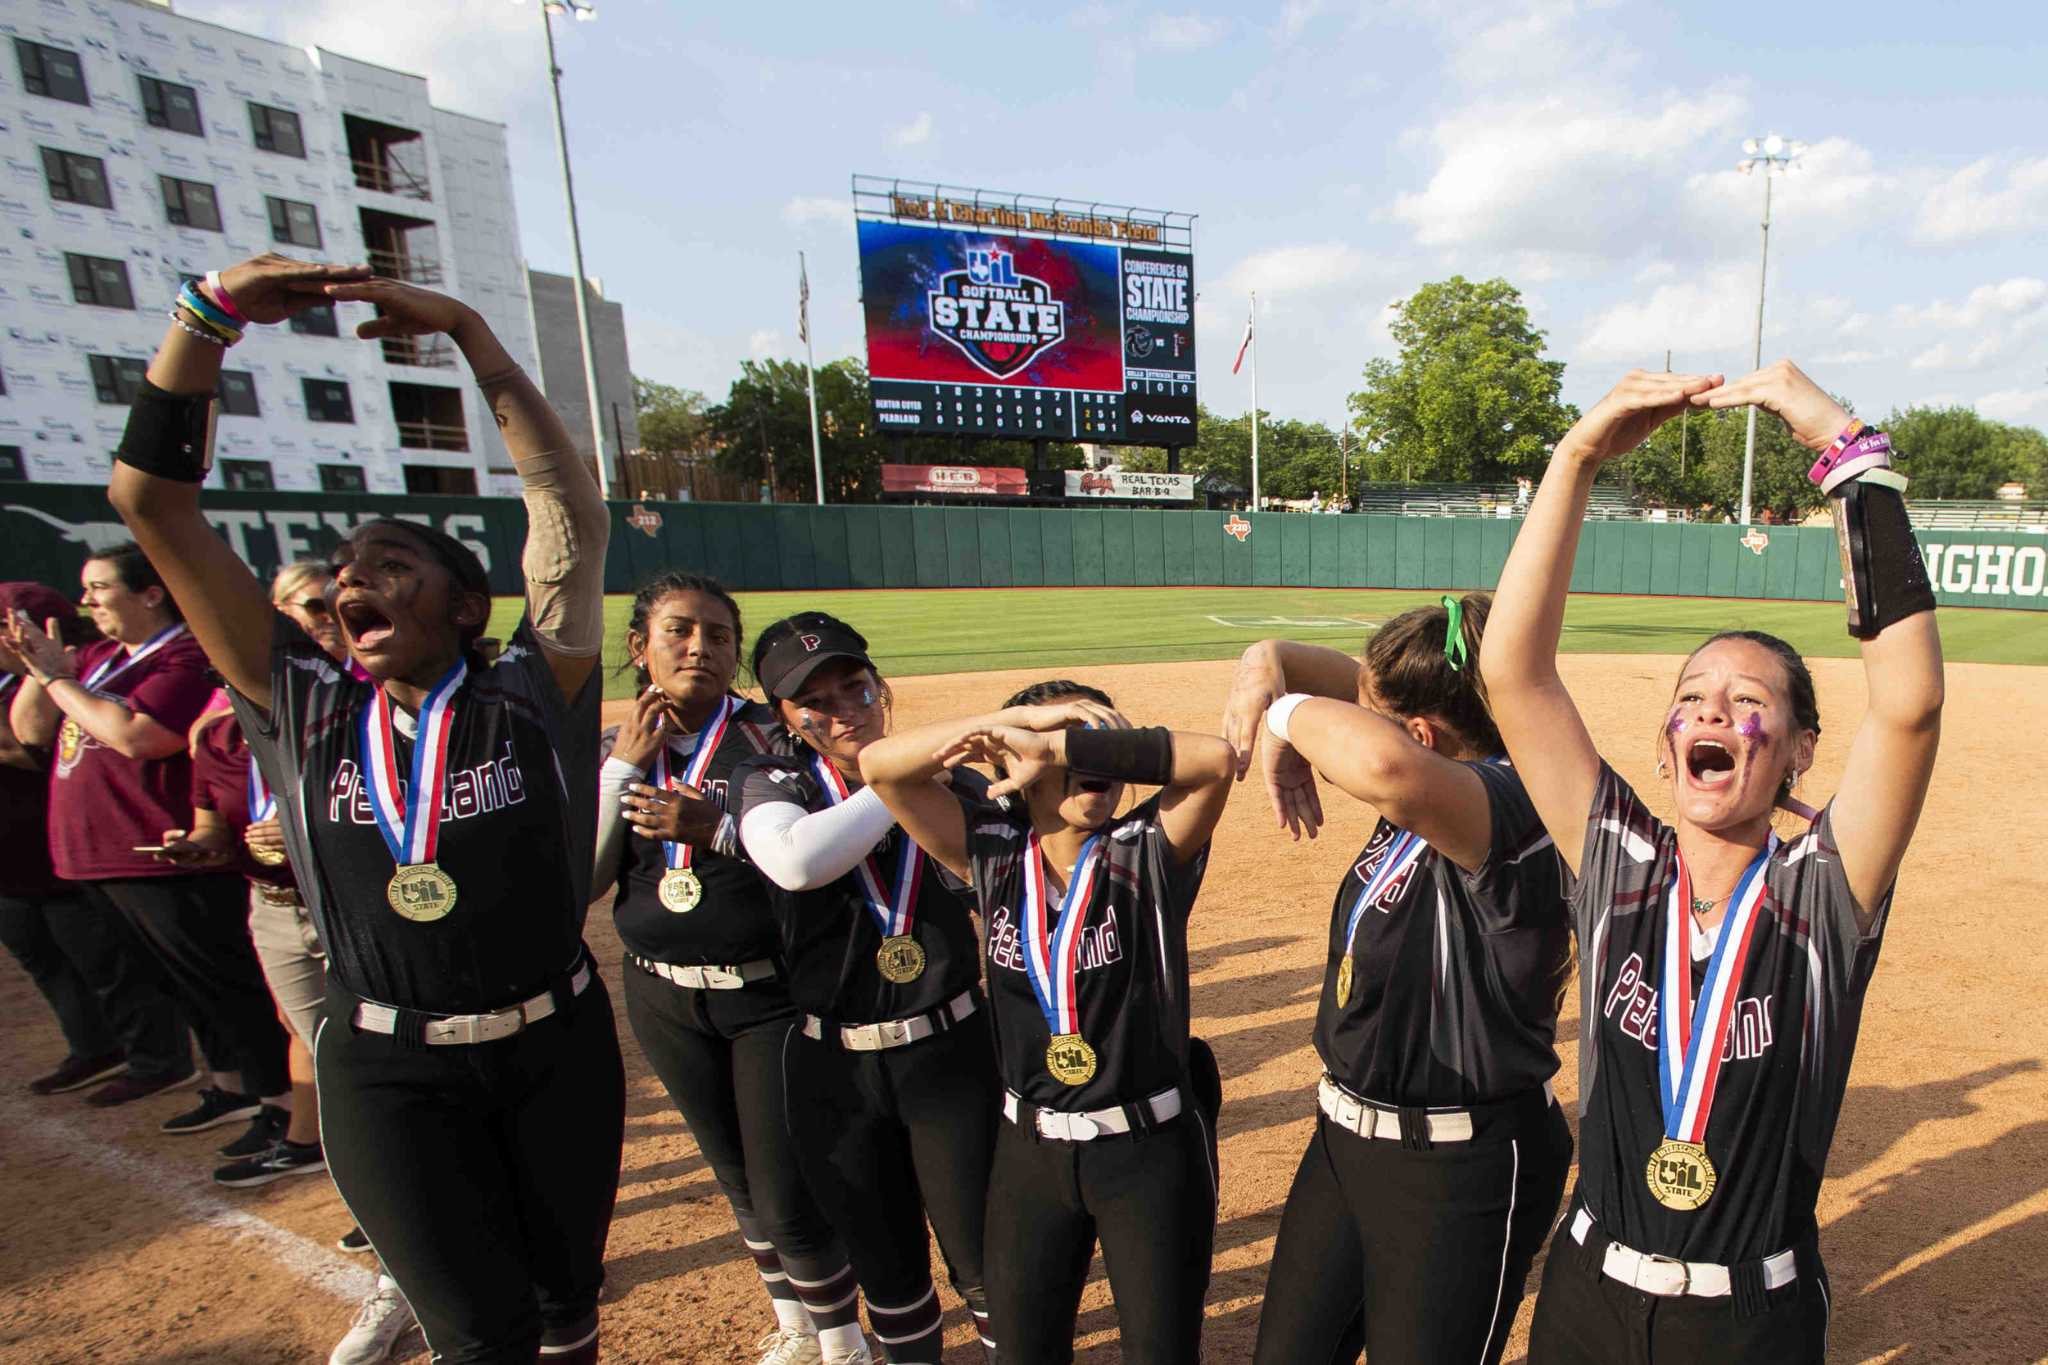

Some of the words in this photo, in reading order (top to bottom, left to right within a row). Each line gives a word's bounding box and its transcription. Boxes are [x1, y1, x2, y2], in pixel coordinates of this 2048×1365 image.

[1124, 259, 1176, 277] CONFERENCE
[961, 285, 1031, 302] SOFTBALL
[1126, 274, 1188, 311] STATE
[934, 296, 1060, 334] STATE
[1126, 307, 1190, 325] CHAMPIONSHIP
[960, 329, 1038, 345] CHAMPIONSHIPS
[935, 385, 941, 395] 1
[976, 387, 983, 397] 3
[1054, 392, 1061, 401] 7
[936, 401, 942, 411] 2
[1111, 410, 1116, 419] 1
[1111, 423, 1117, 432] 1
[1121, 474, 1147, 485] REAL
[1149, 476, 1180, 487] TEXAS
[202, 508, 491, 578] TES
[800, 634, 821, 651] P
[330, 741, 526, 824] Peand
[1665, 1186, 1693, 1197] STATE
